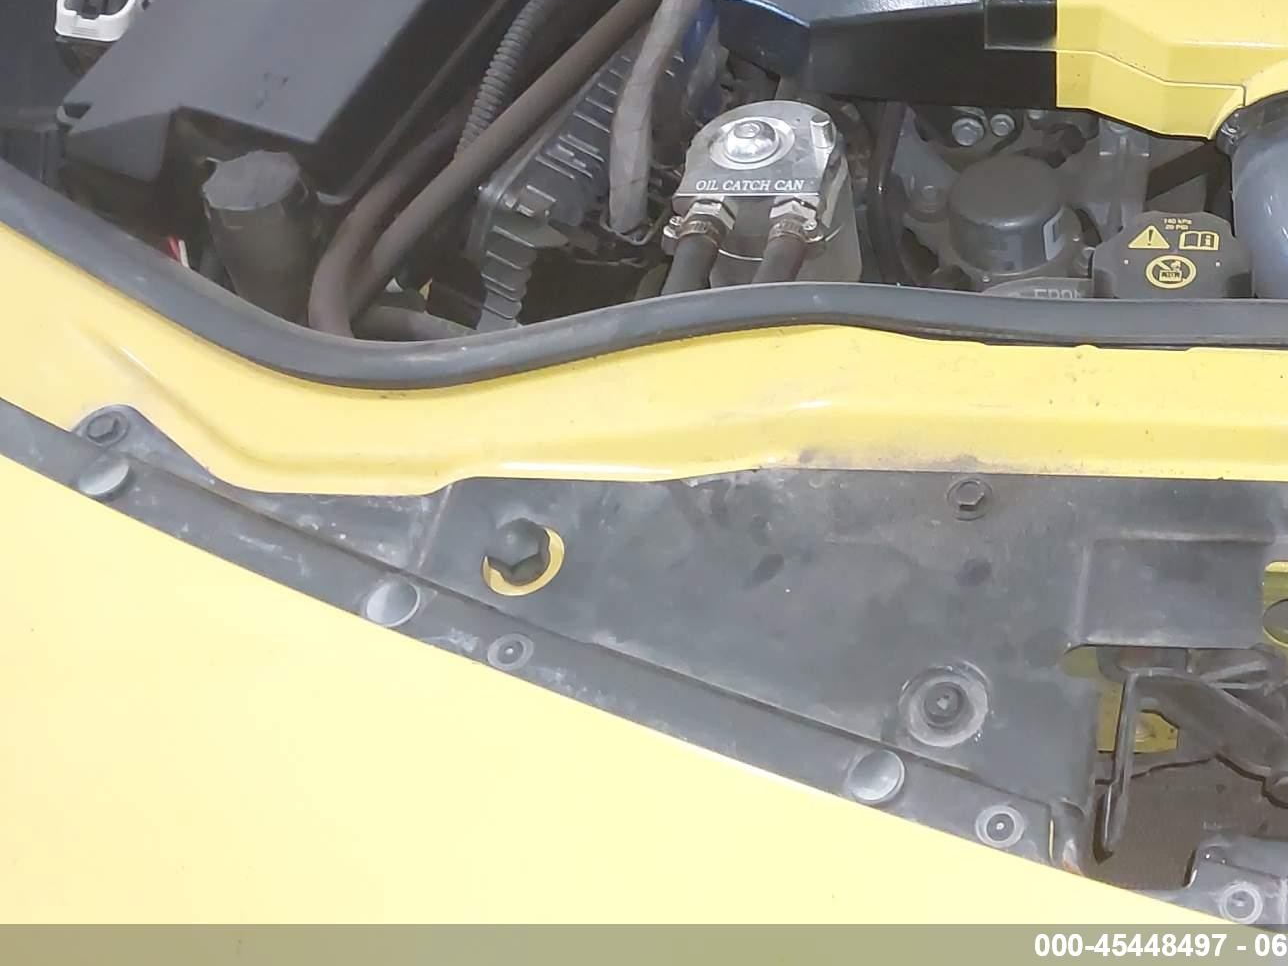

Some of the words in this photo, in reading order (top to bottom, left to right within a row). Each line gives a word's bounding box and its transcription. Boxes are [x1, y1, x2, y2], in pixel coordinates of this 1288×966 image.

[696, 180, 718, 191] OIL
[722, 180, 769, 191] CATCH
[774, 180, 805, 191] CAN
